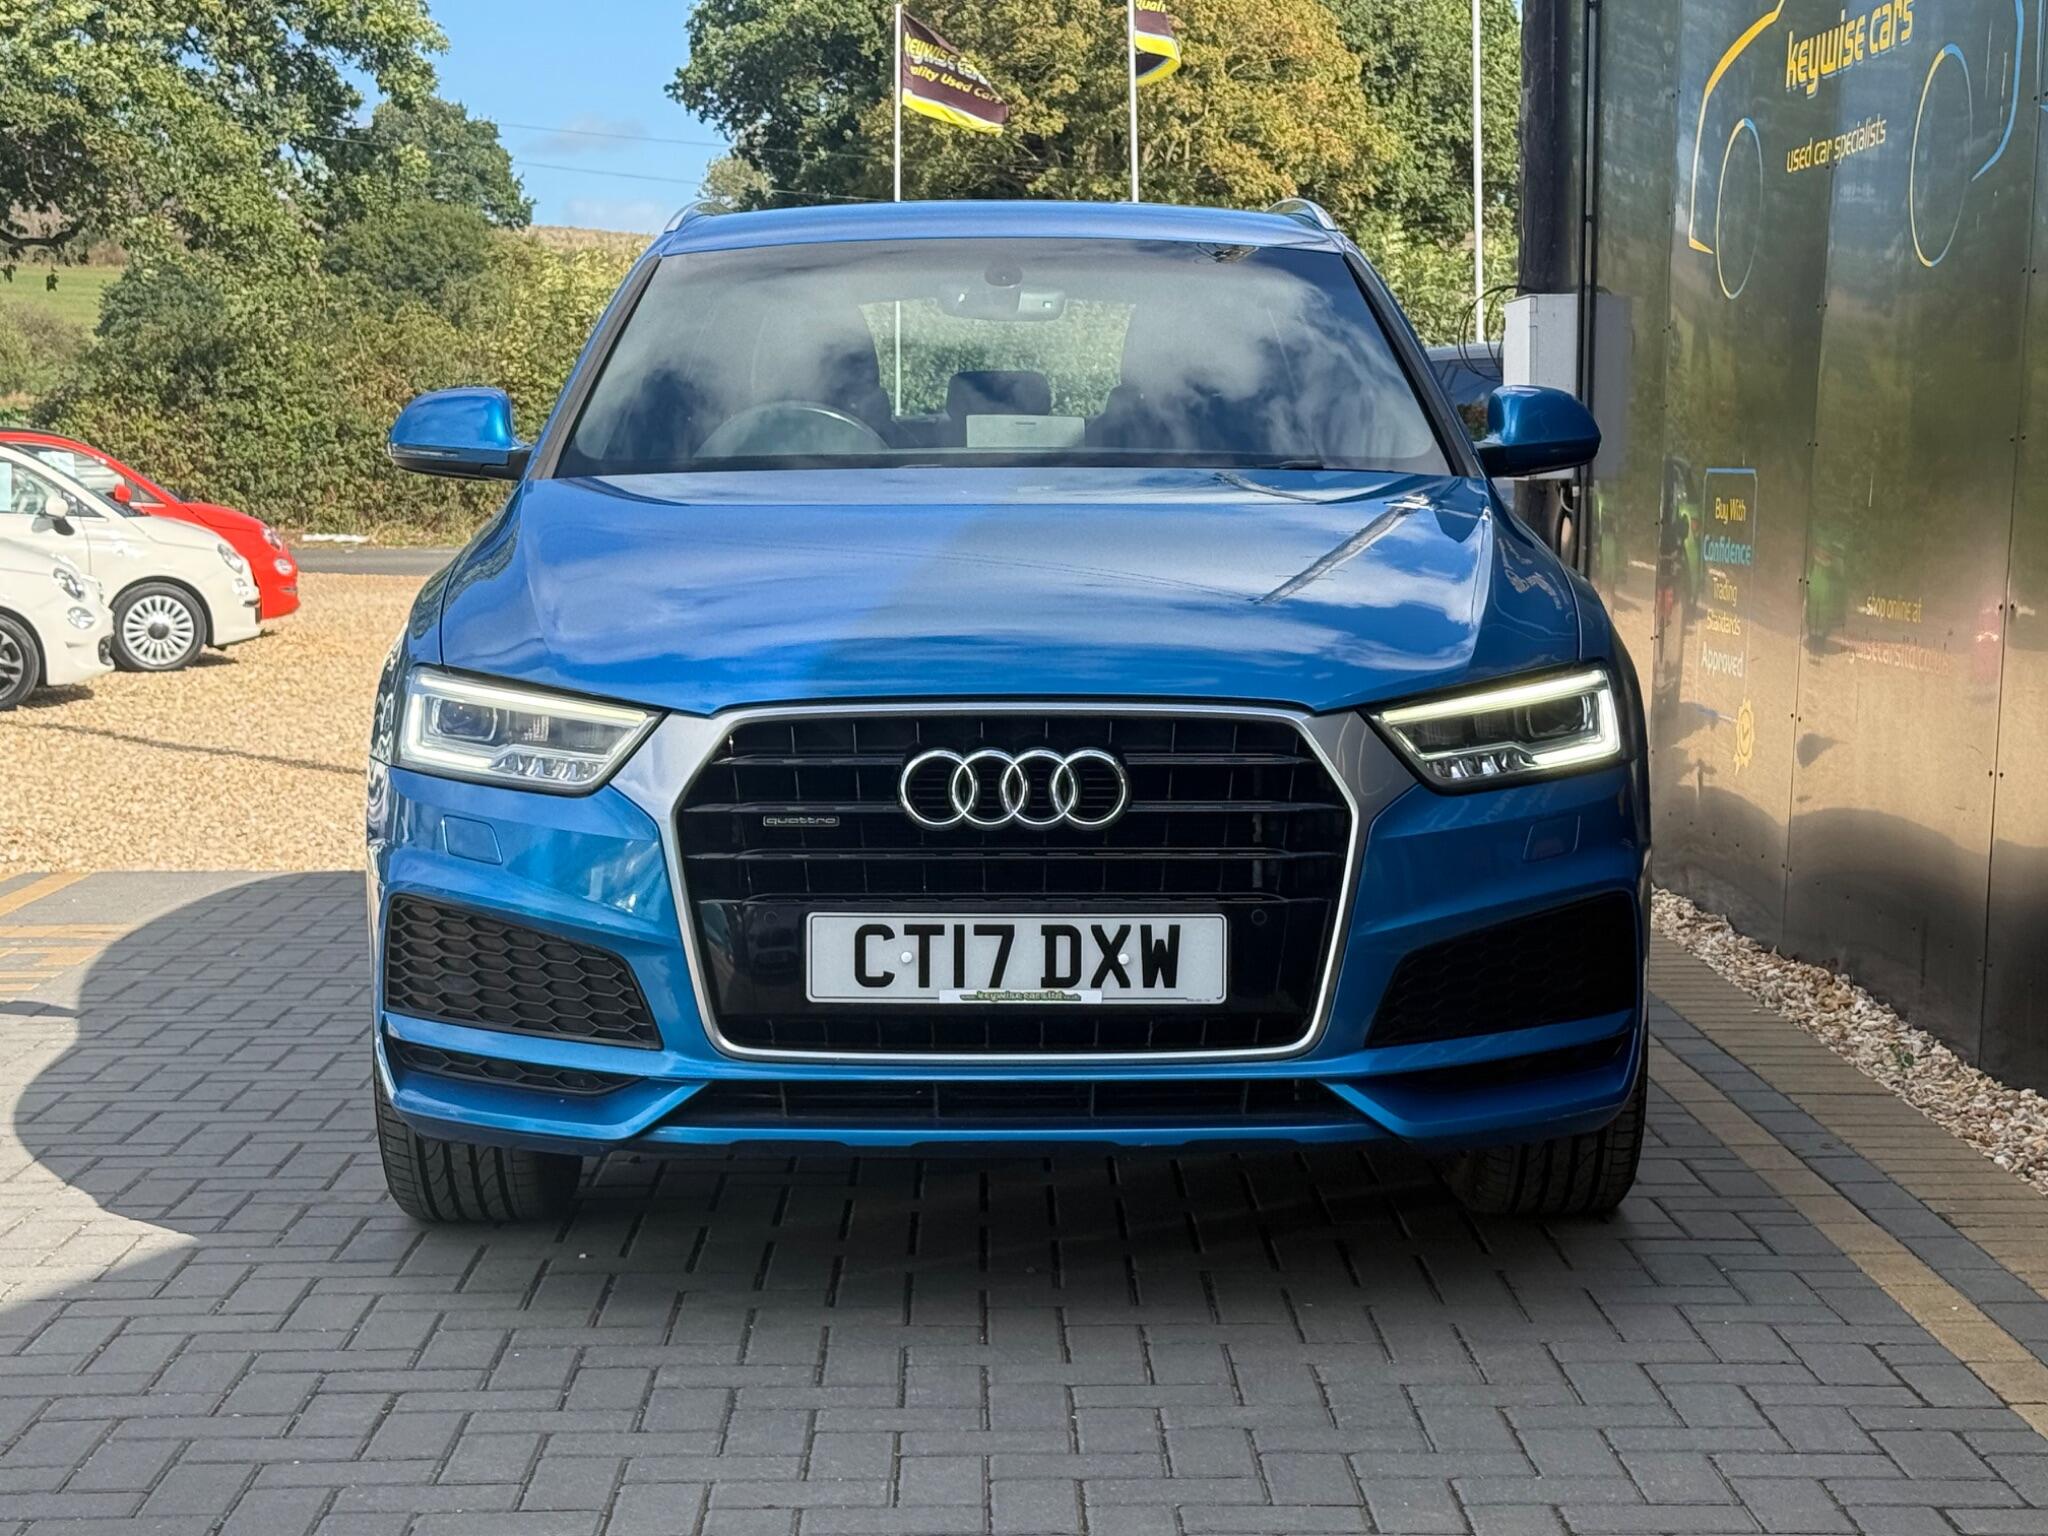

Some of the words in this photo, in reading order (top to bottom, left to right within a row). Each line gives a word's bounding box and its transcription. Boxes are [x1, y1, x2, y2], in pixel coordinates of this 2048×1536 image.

[1785, 9, 1866, 97] keywise
[1869, 0, 1914, 58] cars
[910, 65, 939, 82] ality
[940, 73, 973, 92] Used
[1786, 138, 1812, 173] used
[1814, 139, 1832, 165] car
[1833, 113, 1887, 165] specialists
[1715, 497, 1729, 524] Buy
[1729, 499, 1746, 521] With
[1703, 534, 1752, 566] Confidence
[1712, 577, 1738, 607] Trading
[1866, 592, 1886, 621] shop
[1911, 597, 1922, 624] at
[1706, 608, 1741, 636] Standards
[1701, 641, 1744, 678] Approved
[765, 816, 837, 825] quattro
[854, 924, 1015, 988] CT17
[1040, 924, 1181, 988] DXW
